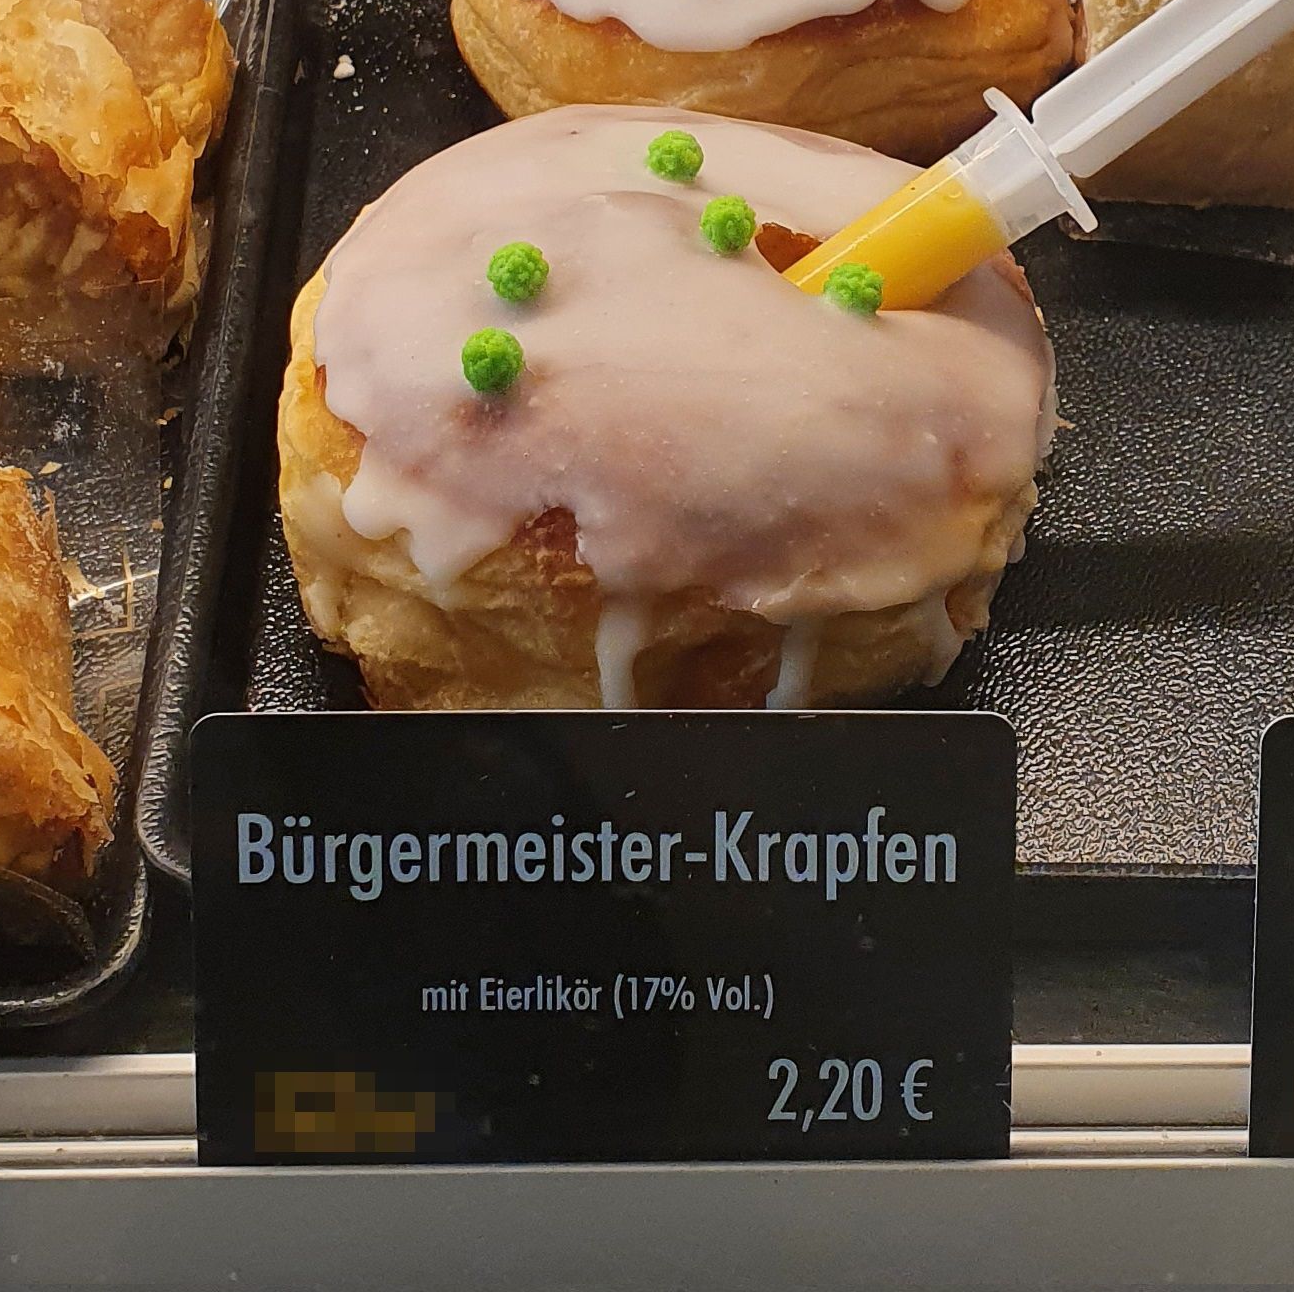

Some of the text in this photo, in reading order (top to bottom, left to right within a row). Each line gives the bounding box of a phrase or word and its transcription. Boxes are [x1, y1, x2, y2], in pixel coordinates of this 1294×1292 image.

[237, 806, 958, 901] Bürgermeister-Krapfen
[422, 973, 775, 1020] mit Eierlikör (17% Vol.)
[767, 1058, 934, 1133] 2,20 €
